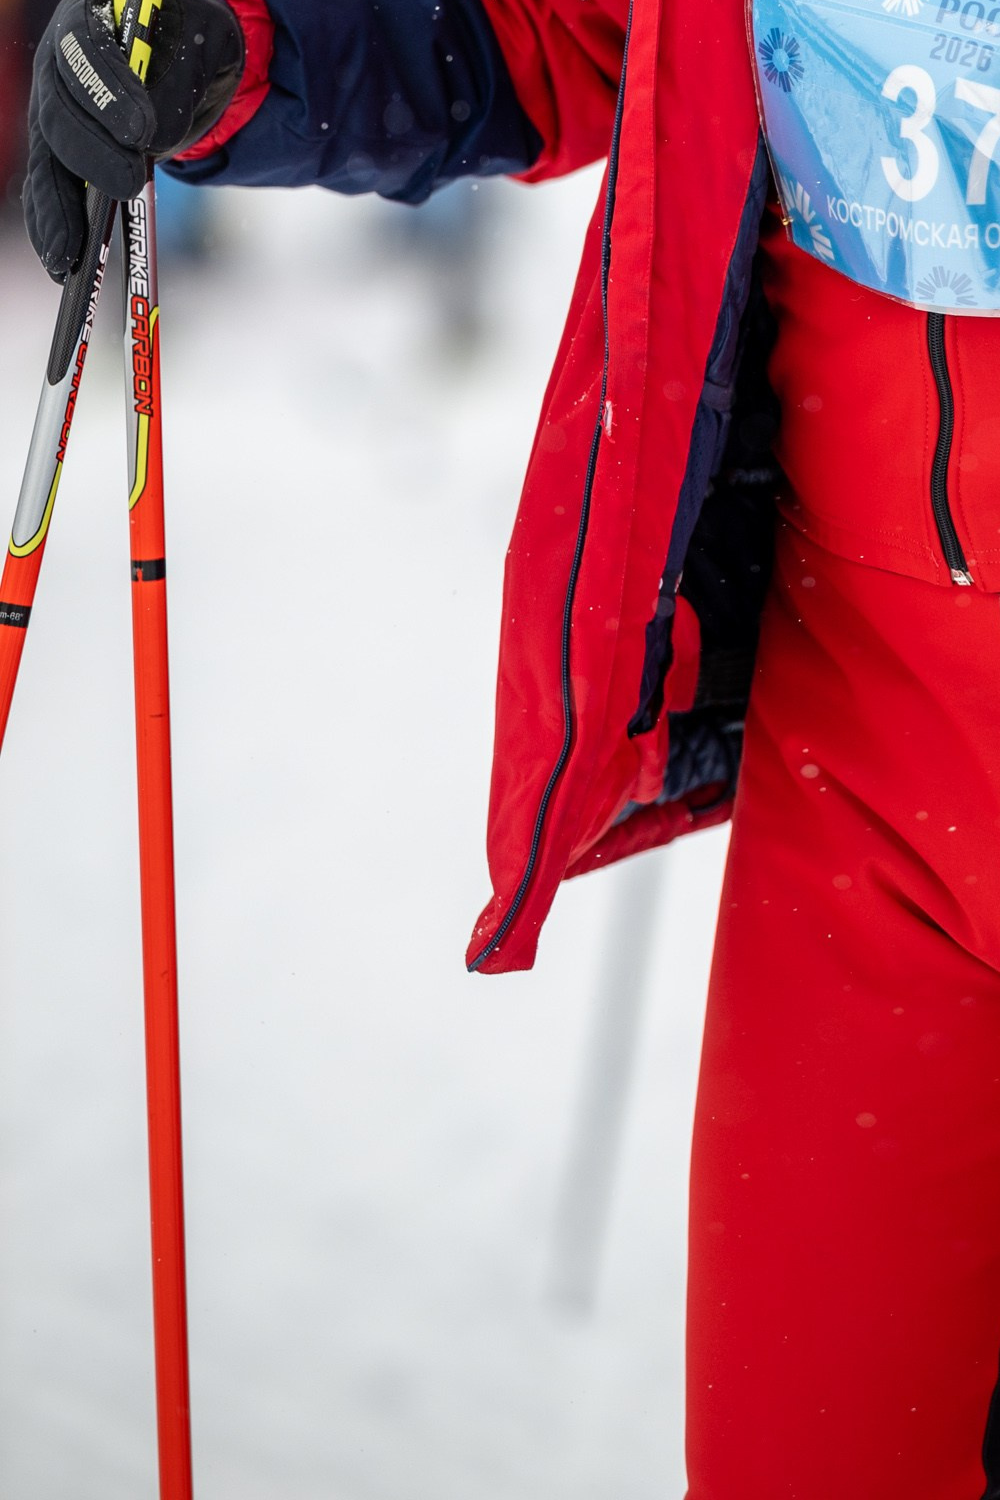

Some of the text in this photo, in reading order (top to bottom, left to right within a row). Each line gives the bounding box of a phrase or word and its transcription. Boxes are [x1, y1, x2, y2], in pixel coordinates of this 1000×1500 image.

[929, 33, 995, 73] 2026
[826, 194, 979, 250] КОСТРОМСКАЯ
[128, 197, 154, 418] STRIKE CARBON
